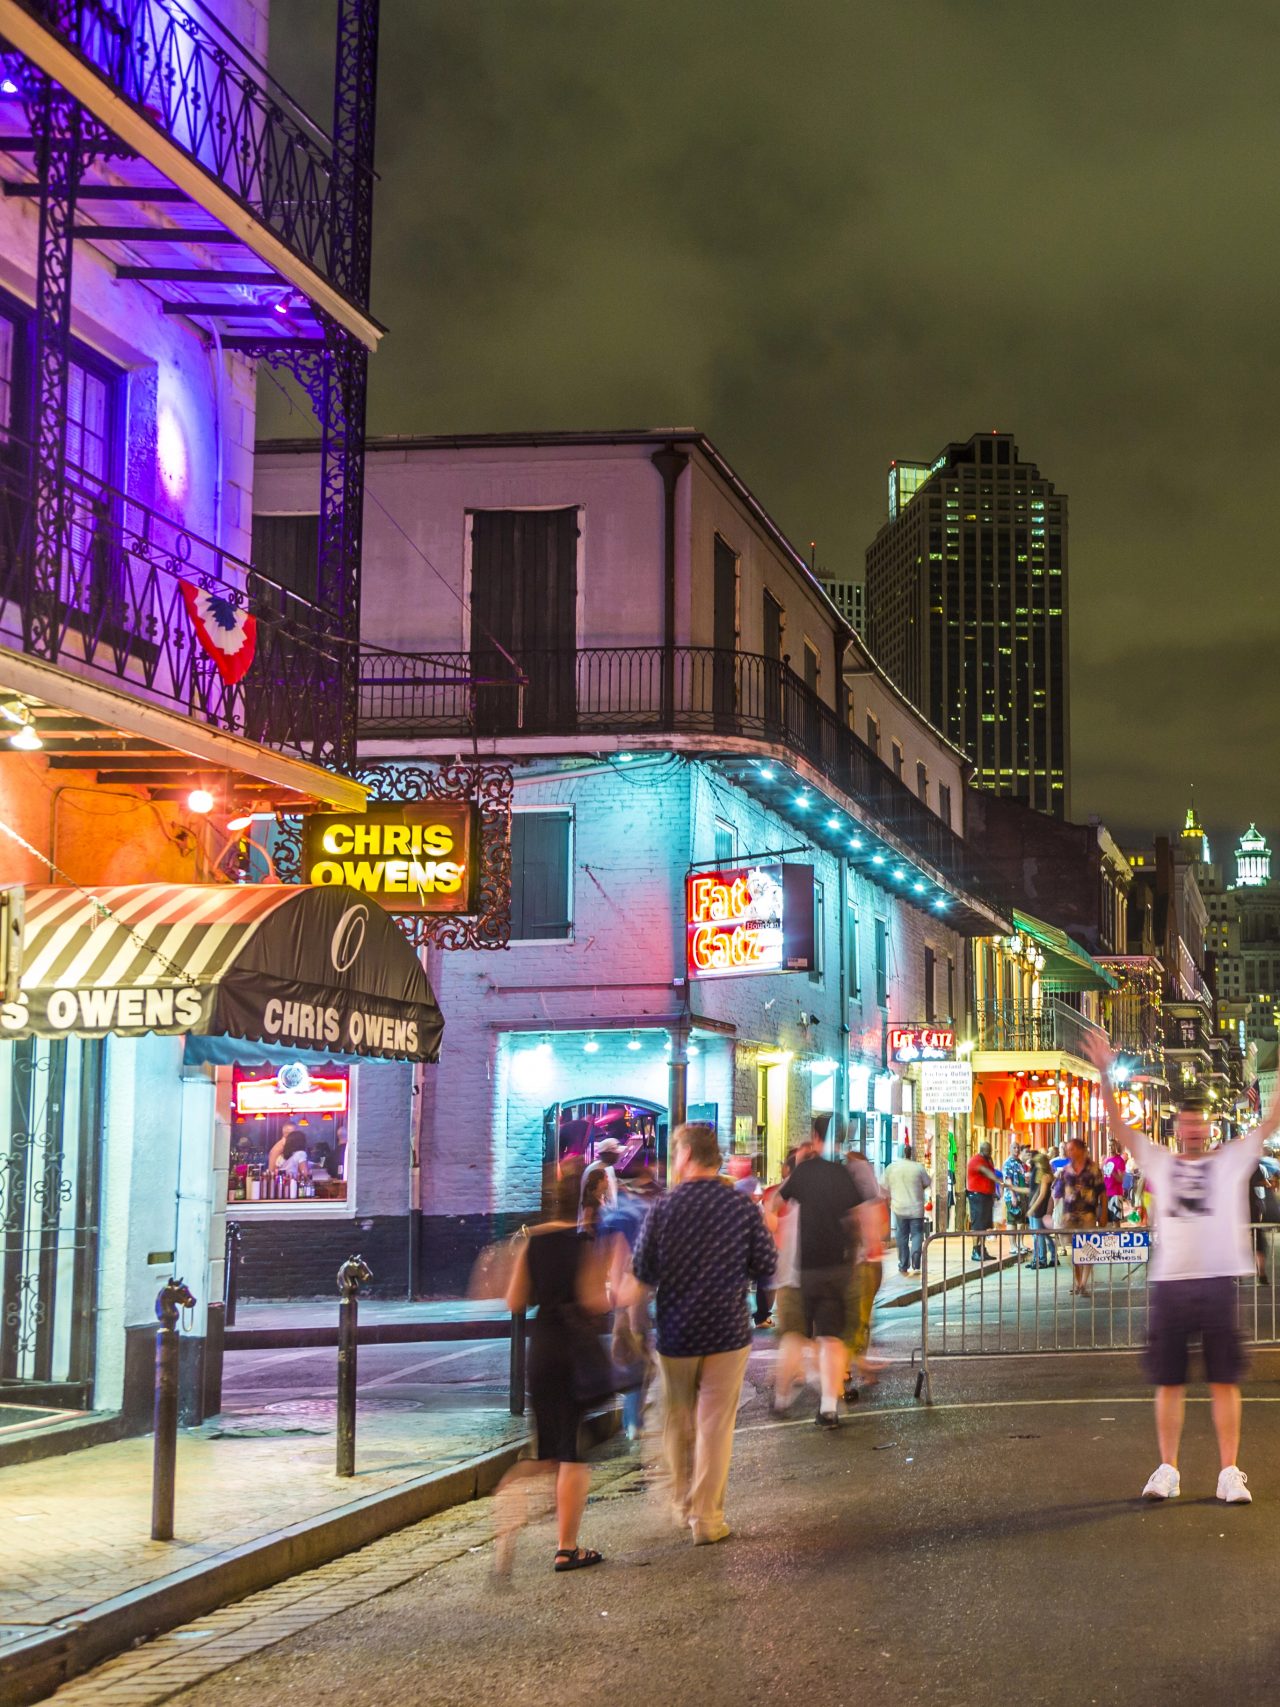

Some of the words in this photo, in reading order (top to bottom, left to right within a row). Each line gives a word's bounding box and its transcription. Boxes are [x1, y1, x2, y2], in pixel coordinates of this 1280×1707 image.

[322, 823, 454, 857] CHRIS
[310, 860, 465, 893] OWENS
[692, 877, 746, 922] Fat
[692, 926, 762, 970] Catz
[47, 988, 202, 1029] OWENS
[264, 999, 340, 1042] CHRIS
[349, 1012, 419, 1053] OWENS
[921, 1029, 953, 1047] CATZ
